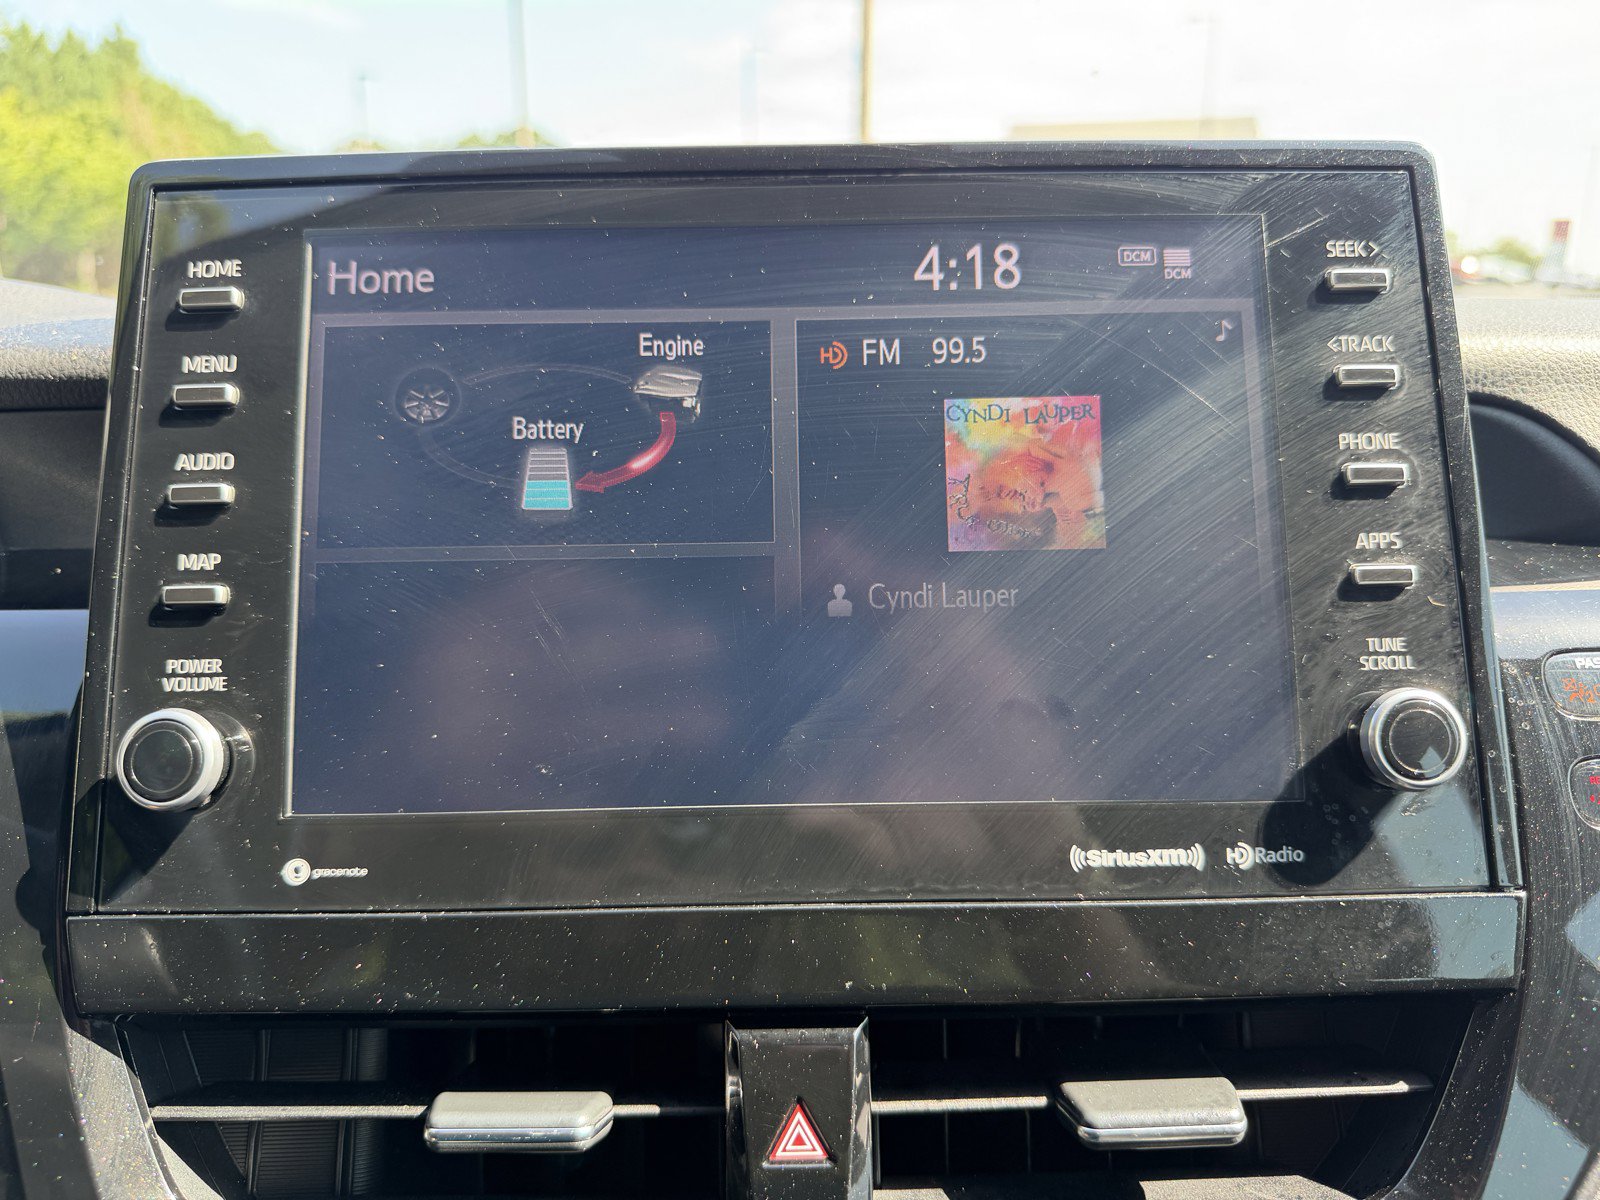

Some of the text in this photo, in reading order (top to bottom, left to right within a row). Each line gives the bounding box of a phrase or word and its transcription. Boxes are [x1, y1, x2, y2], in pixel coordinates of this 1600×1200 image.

[1123, 250, 1151, 262] DCM
[187, 259, 242, 279] HOME
[913, 243, 1022, 291] 4:18
[1164, 268, 1192, 280] DCM
[327, 260, 435, 296] Home
[638, 332, 705, 361] Engine
[862, 338, 901, 366] FM
[931, 336, 988, 365] 99.5
[181, 354, 238, 373] MENU
[1023, 403, 1095, 425] LAUPER
[512, 415, 585, 444] Battery
[1338, 432, 1400, 450] PHONE
[174, 452, 235, 471] AUDIO
[1355, 532, 1403, 550] APPS
[177, 553, 222, 571] MAP
[868, 582, 1019, 615] Cyndi Lauper
[1365, 637, 1408, 652] TUNE
[165, 658, 223, 675] POWER
[1358, 655, 1417, 671] SCROLL
[161, 676, 229, 693] VOLUME
[1255, 846, 1305, 864] Radio
[310, 867, 369, 880] gracenote
